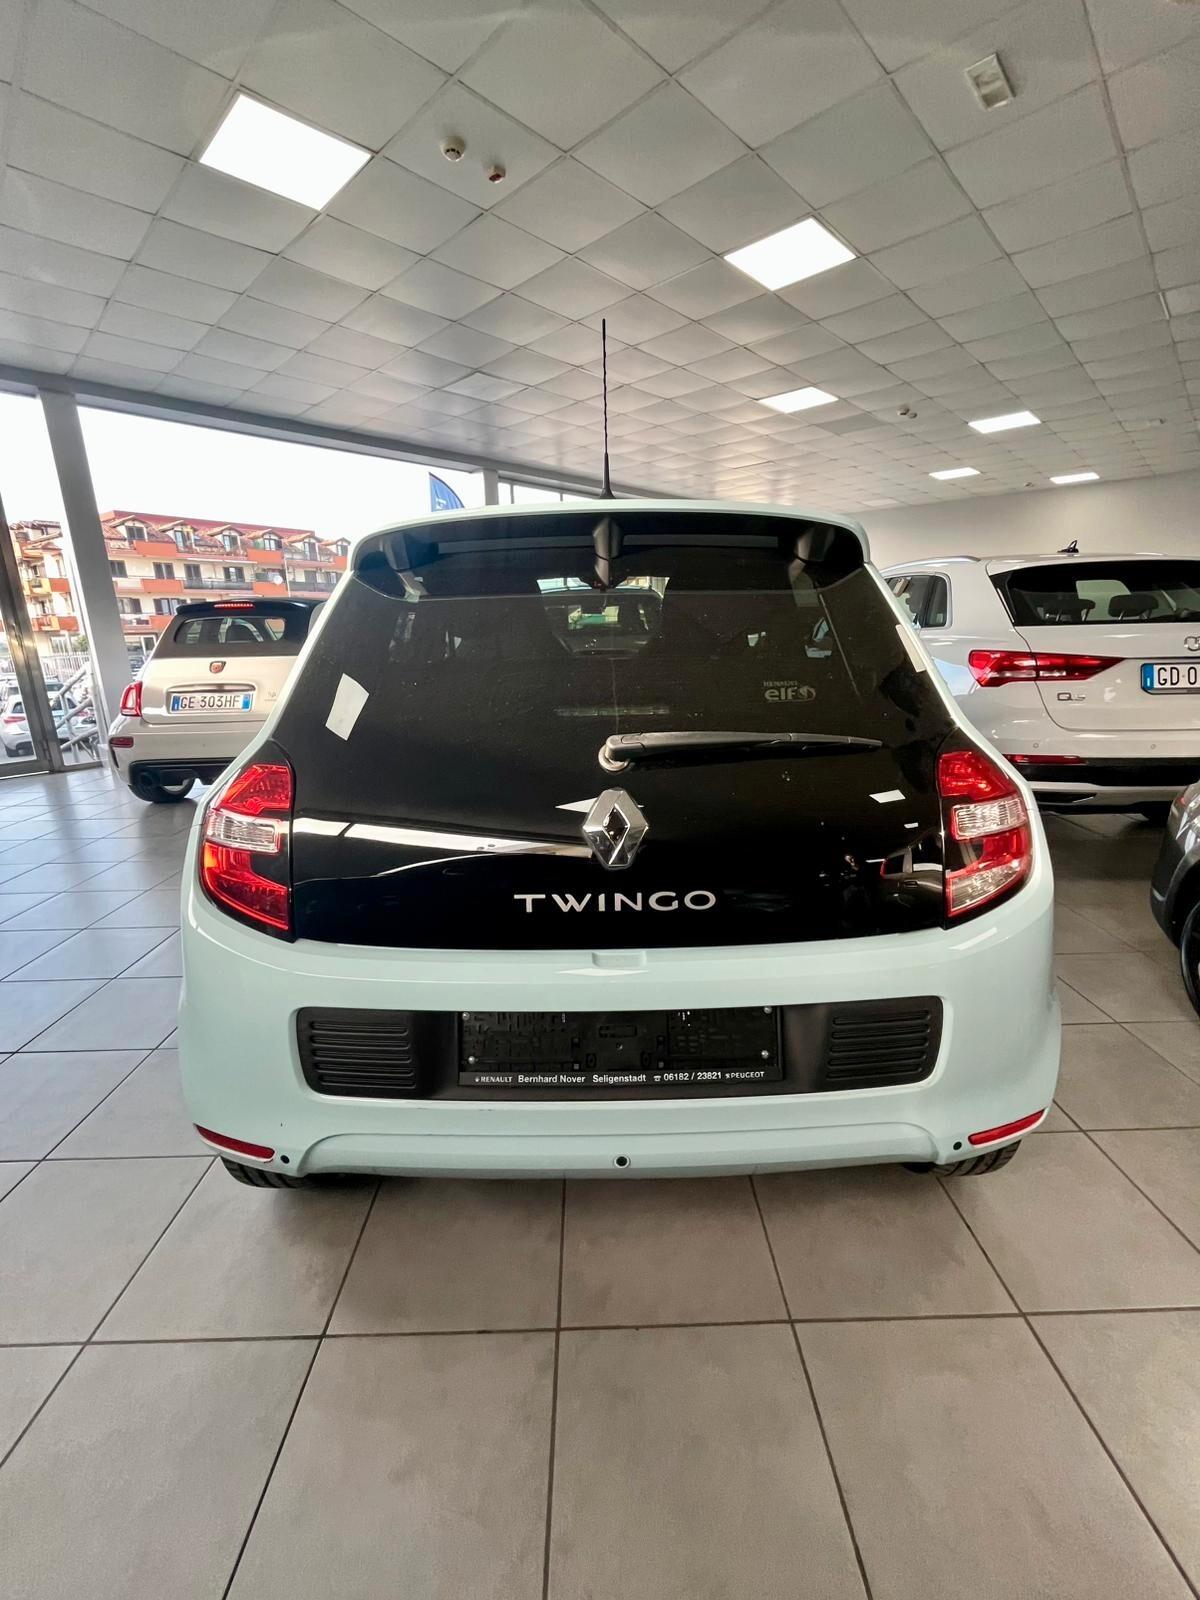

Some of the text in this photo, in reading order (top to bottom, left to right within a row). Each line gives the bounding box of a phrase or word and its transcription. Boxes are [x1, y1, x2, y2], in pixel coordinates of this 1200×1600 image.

[1157, 667, 1180, 686] GD
[764, 686, 798, 700] elf
[180, 695, 241, 709] GE 303HF
[513, 890, 717, 913] TWINGO
[518, 1074, 557, 1083] Bernhard
[559, 1074, 586, 1083] Nover
[592, 1073, 647, 1085] Seligenstadt
[663, 1072, 690, 1081] 06182
[697, 1071, 722, 1080] 23821
[731, 1071, 765, 1079] PEUGEOT
